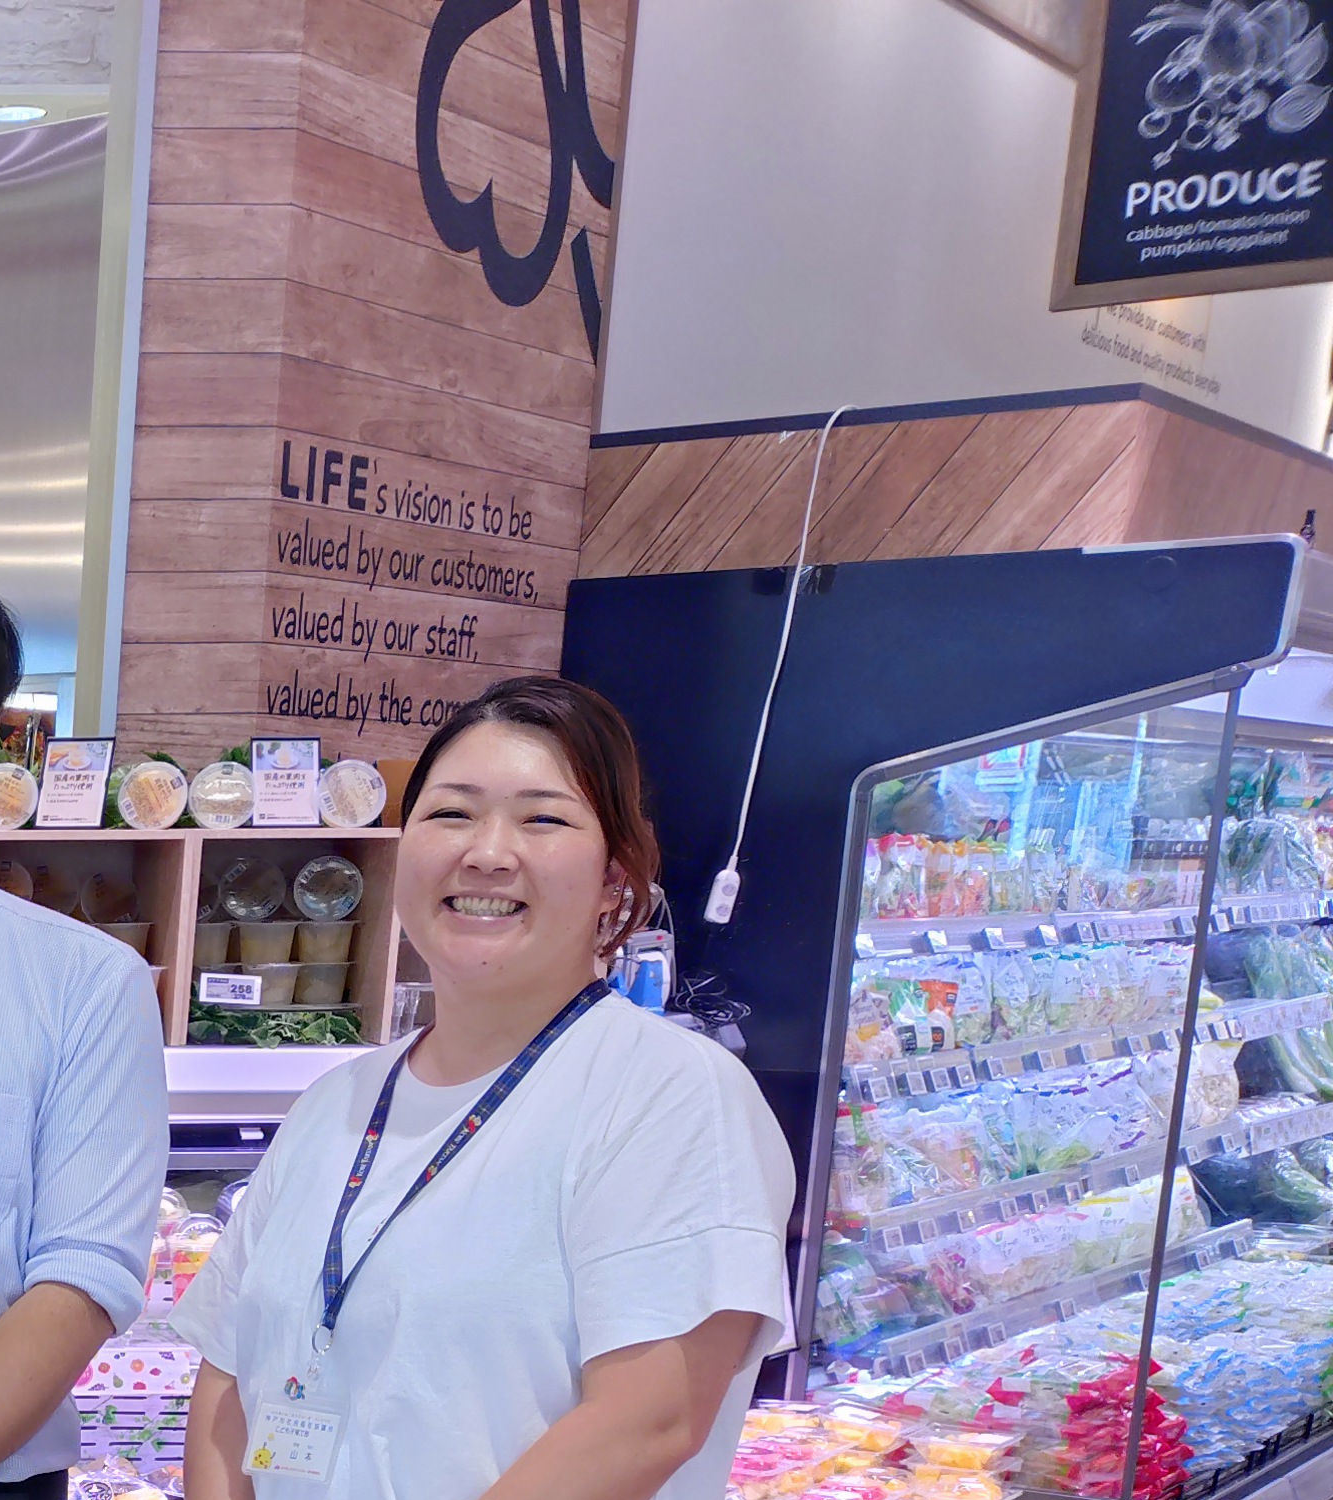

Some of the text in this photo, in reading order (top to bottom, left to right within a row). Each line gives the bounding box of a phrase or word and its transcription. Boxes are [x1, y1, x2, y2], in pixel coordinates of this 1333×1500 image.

[1124, 158, 1328, 220] PRODUCE
[394, 480, 532, 540] vision is to be
[277, 518, 538, 604] valued by our customers,
[272, 592, 478, 662] valued by our staff,
[266, 669, 413, 736] valued by the
